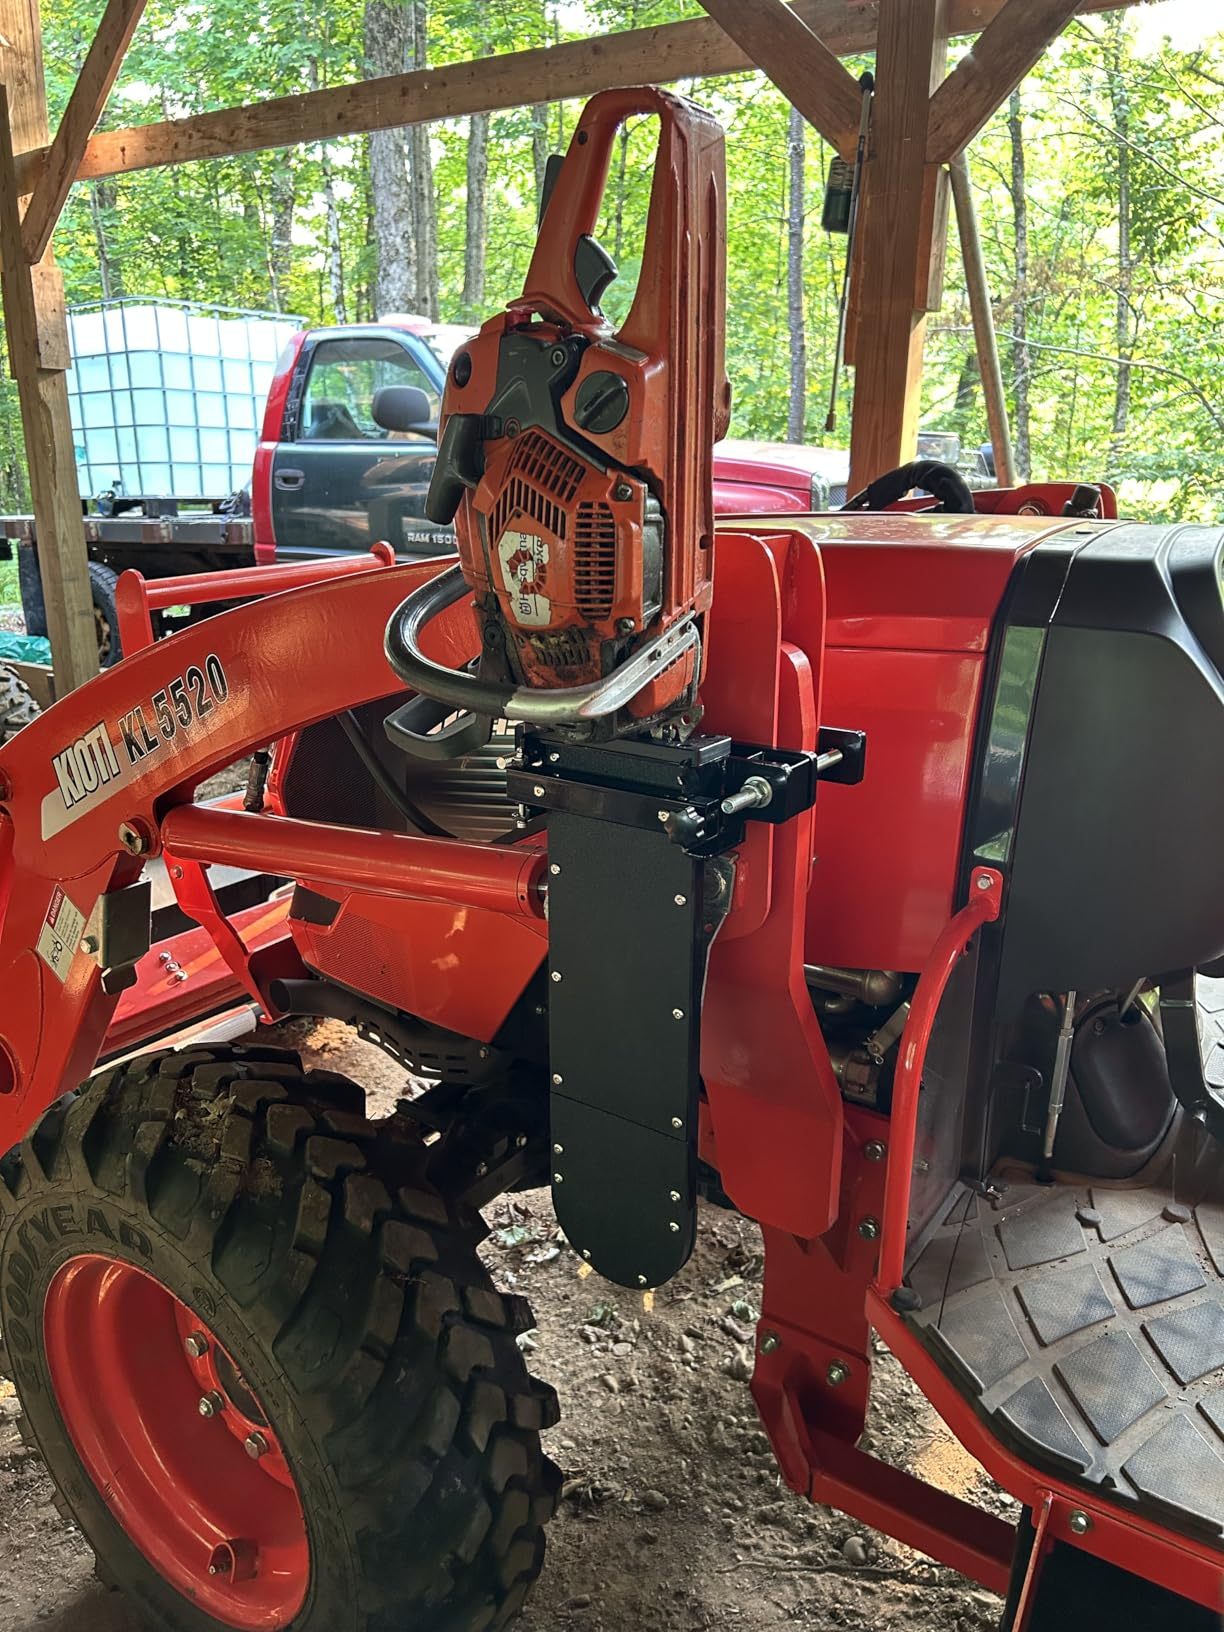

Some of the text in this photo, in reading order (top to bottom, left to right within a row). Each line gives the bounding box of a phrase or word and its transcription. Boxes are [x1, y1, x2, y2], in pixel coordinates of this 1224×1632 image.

[407, 532, 430, 543] RAM
[52, 720, 121, 810] KIOTI
[50, 891, 63, 918] DANGER
[6, 1204, 153, 1393] GOODYEAR
